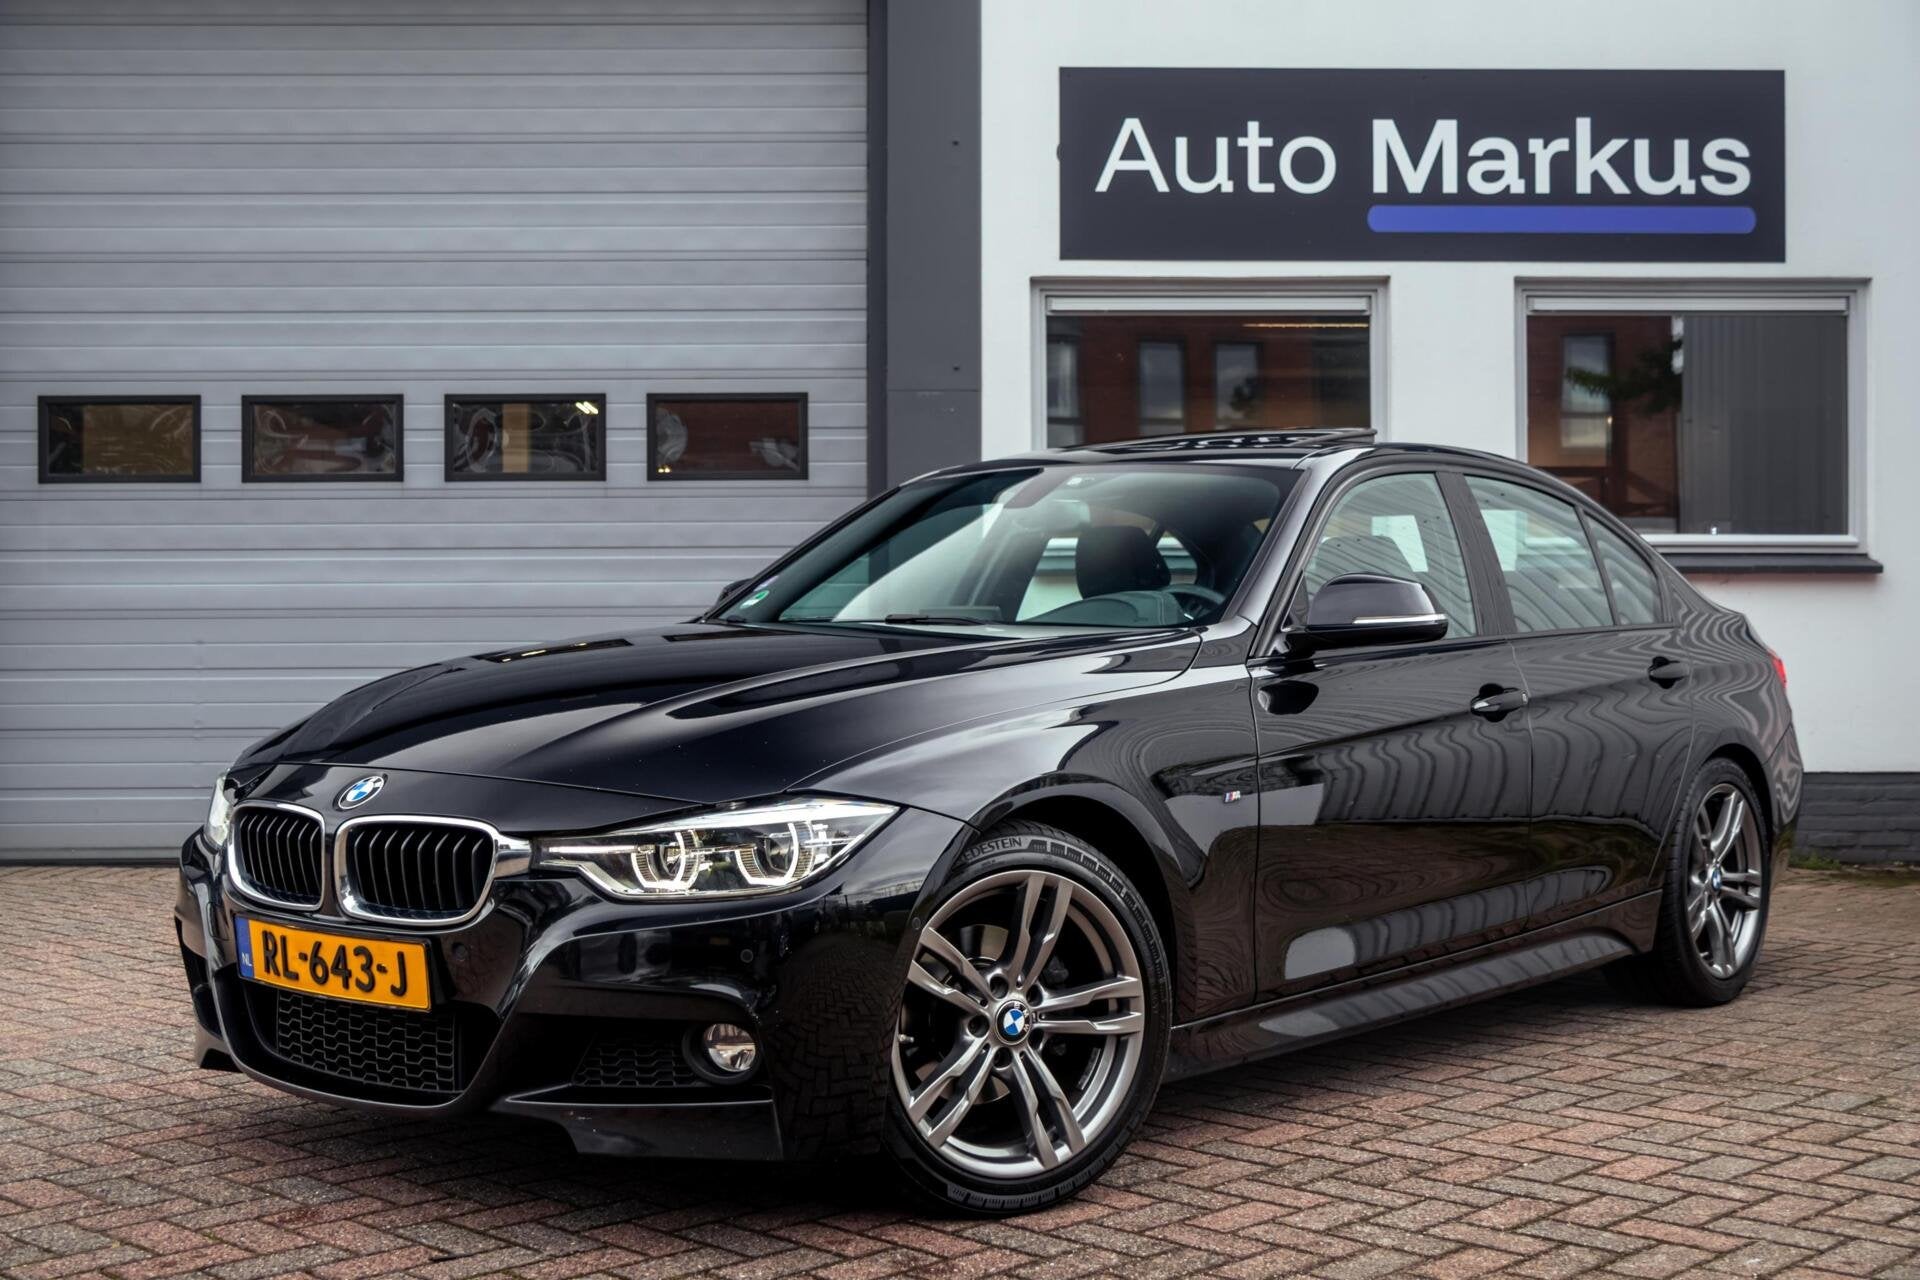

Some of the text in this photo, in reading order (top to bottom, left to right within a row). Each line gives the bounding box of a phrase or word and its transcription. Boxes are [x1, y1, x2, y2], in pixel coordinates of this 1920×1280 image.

[1094, 116, 1752, 197] Auto Markus
[241, 952, 253, 967] NL
[262, 930, 407, 997] RL-643-J
